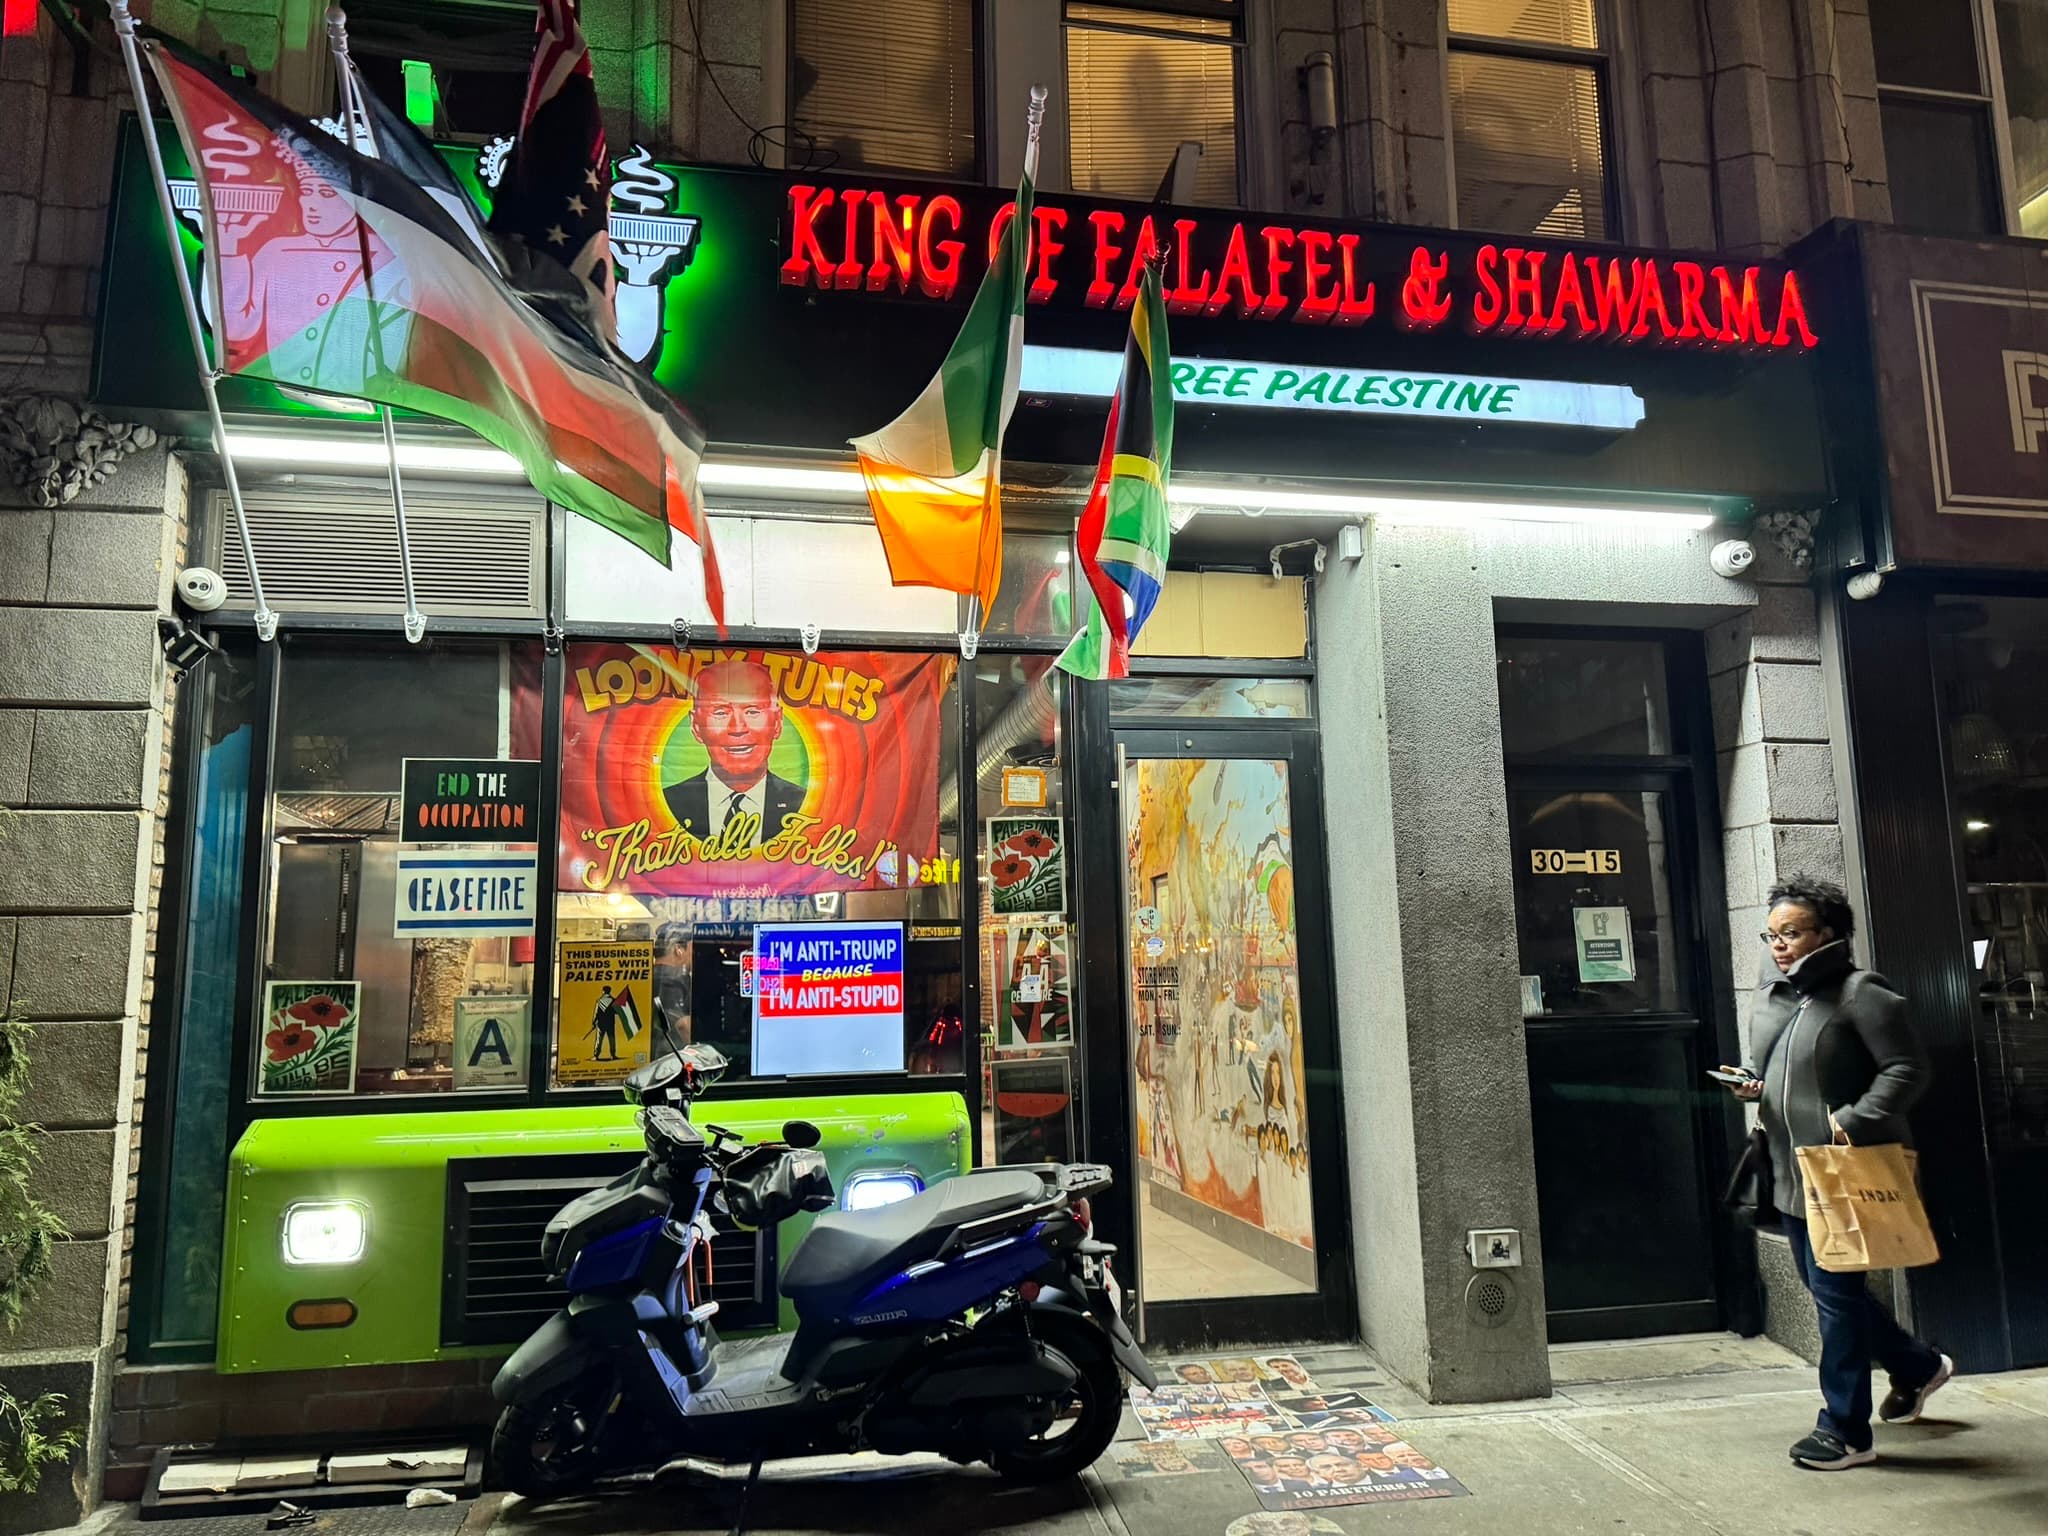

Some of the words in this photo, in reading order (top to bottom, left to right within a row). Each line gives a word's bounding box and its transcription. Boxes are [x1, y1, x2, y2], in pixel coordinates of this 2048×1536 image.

[780, 185, 966, 298] KING
[1086, 210, 1375, 325] FALAFEL
[1401, 245, 1452, 325] &
[1473, 243, 1820, 350] SHAWARMA
[1170, 360, 1258, 399] REE
[1264, 368, 1520, 414] PALESTINE
[762, 650, 884, 722] TUNES
[436, 773, 470, 797] END
[476, 773, 507, 797] THE
[418, 803, 525, 828] OCCUPATION
[697, 811, 761, 861] all
[1533, 851, 1618, 872] 30-15
[408, 877, 525, 912] CEASEFIRE
[1032, 877, 1061, 898] BE
[565, 950, 592, 959] THIS
[594, 948, 650, 958] BUSINESS
[769, 941, 793, 962] I'M
[797, 938, 897, 962] ANTI-TRUMP
[565, 960, 611, 970] STANDS
[618, 960, 650, 968] WITH
[565, 969, 650, 983] PALESTINE
[801, 963, 873, 983] BECAUSE
[1158, 966, 1179, 984] HOURS
[769, 987, 793, 1010] I'M
[796, 985, 899, 1010] ANTI-STUPID
[467, 1018, 513, 1066] A
[314, 1051, 350, 1076] BE
[1294, 1490, 1313, 1499] 10
[1318, 1483, 1408, 1497] PARTNERS
[1410, 1480, 1430, 1490] IN
